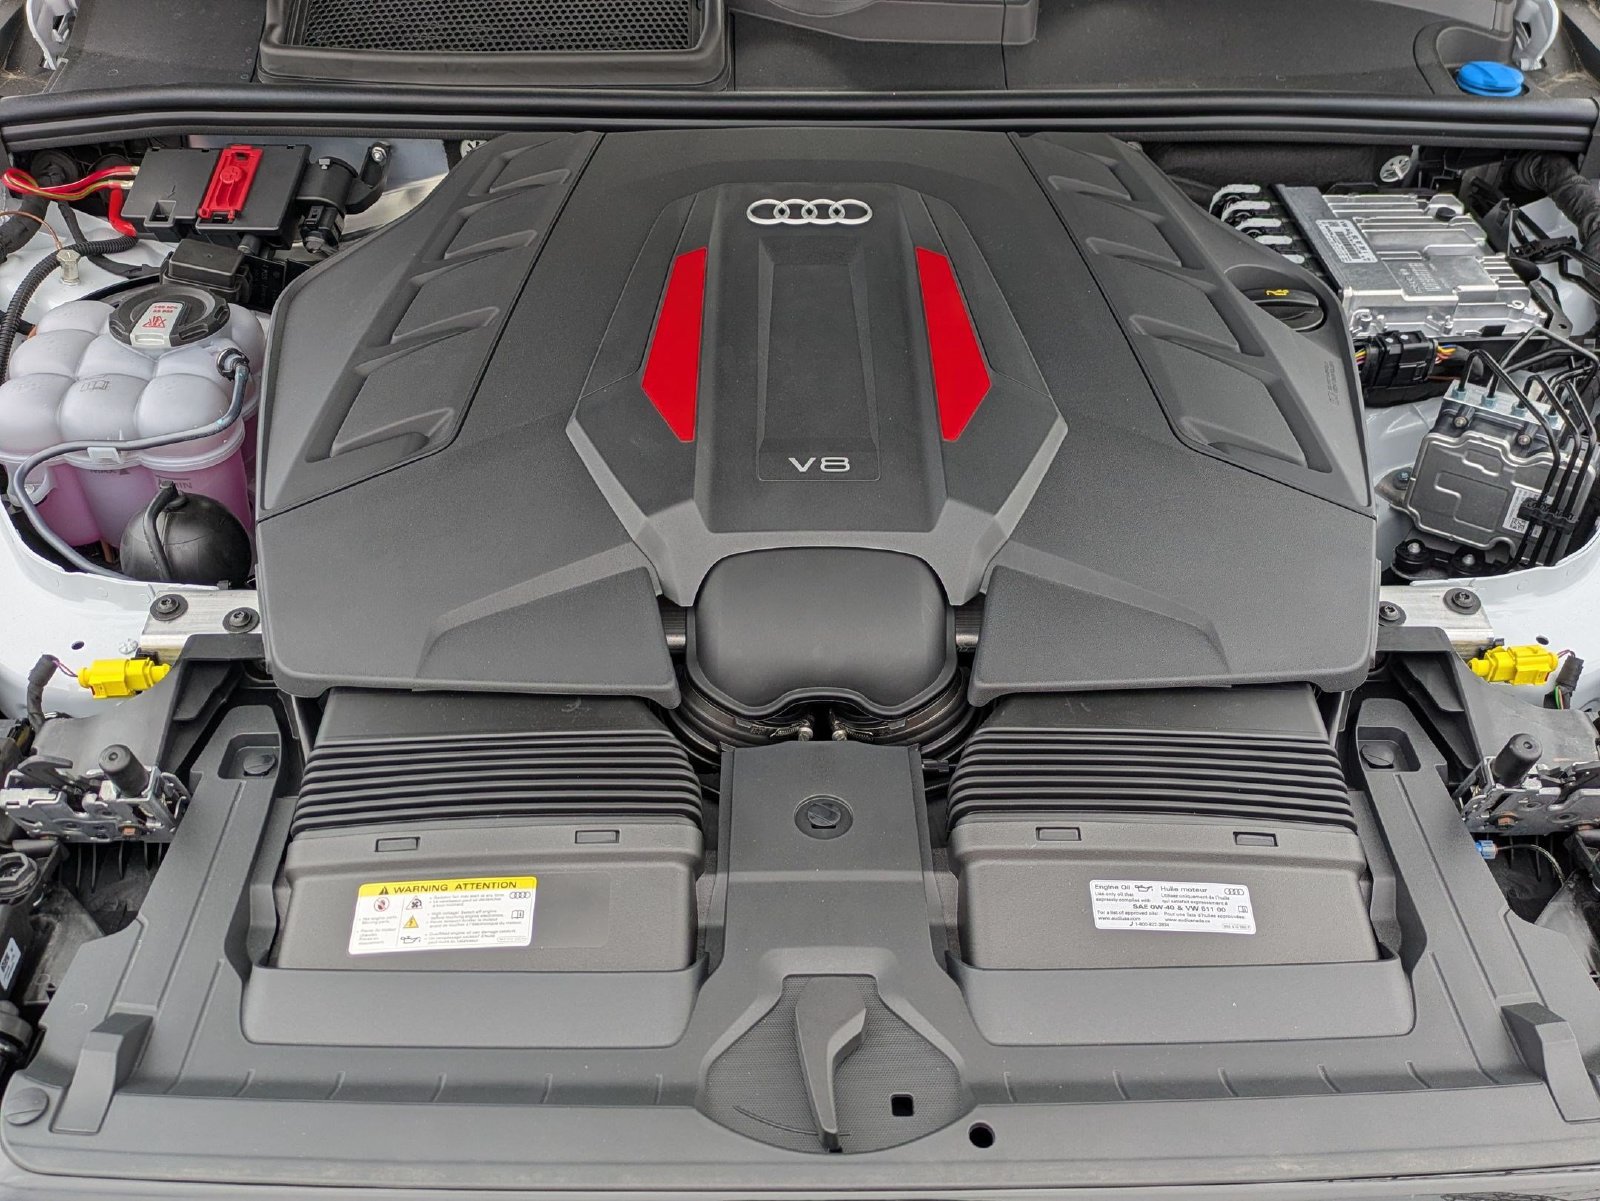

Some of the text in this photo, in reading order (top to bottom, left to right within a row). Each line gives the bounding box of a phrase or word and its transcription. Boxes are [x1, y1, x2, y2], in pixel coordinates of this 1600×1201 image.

[788, 456, 851, 473] V8
[393, 881, 517, 893] WARNING ATTENTION
[1094, 884, 1119, 892] Engine
